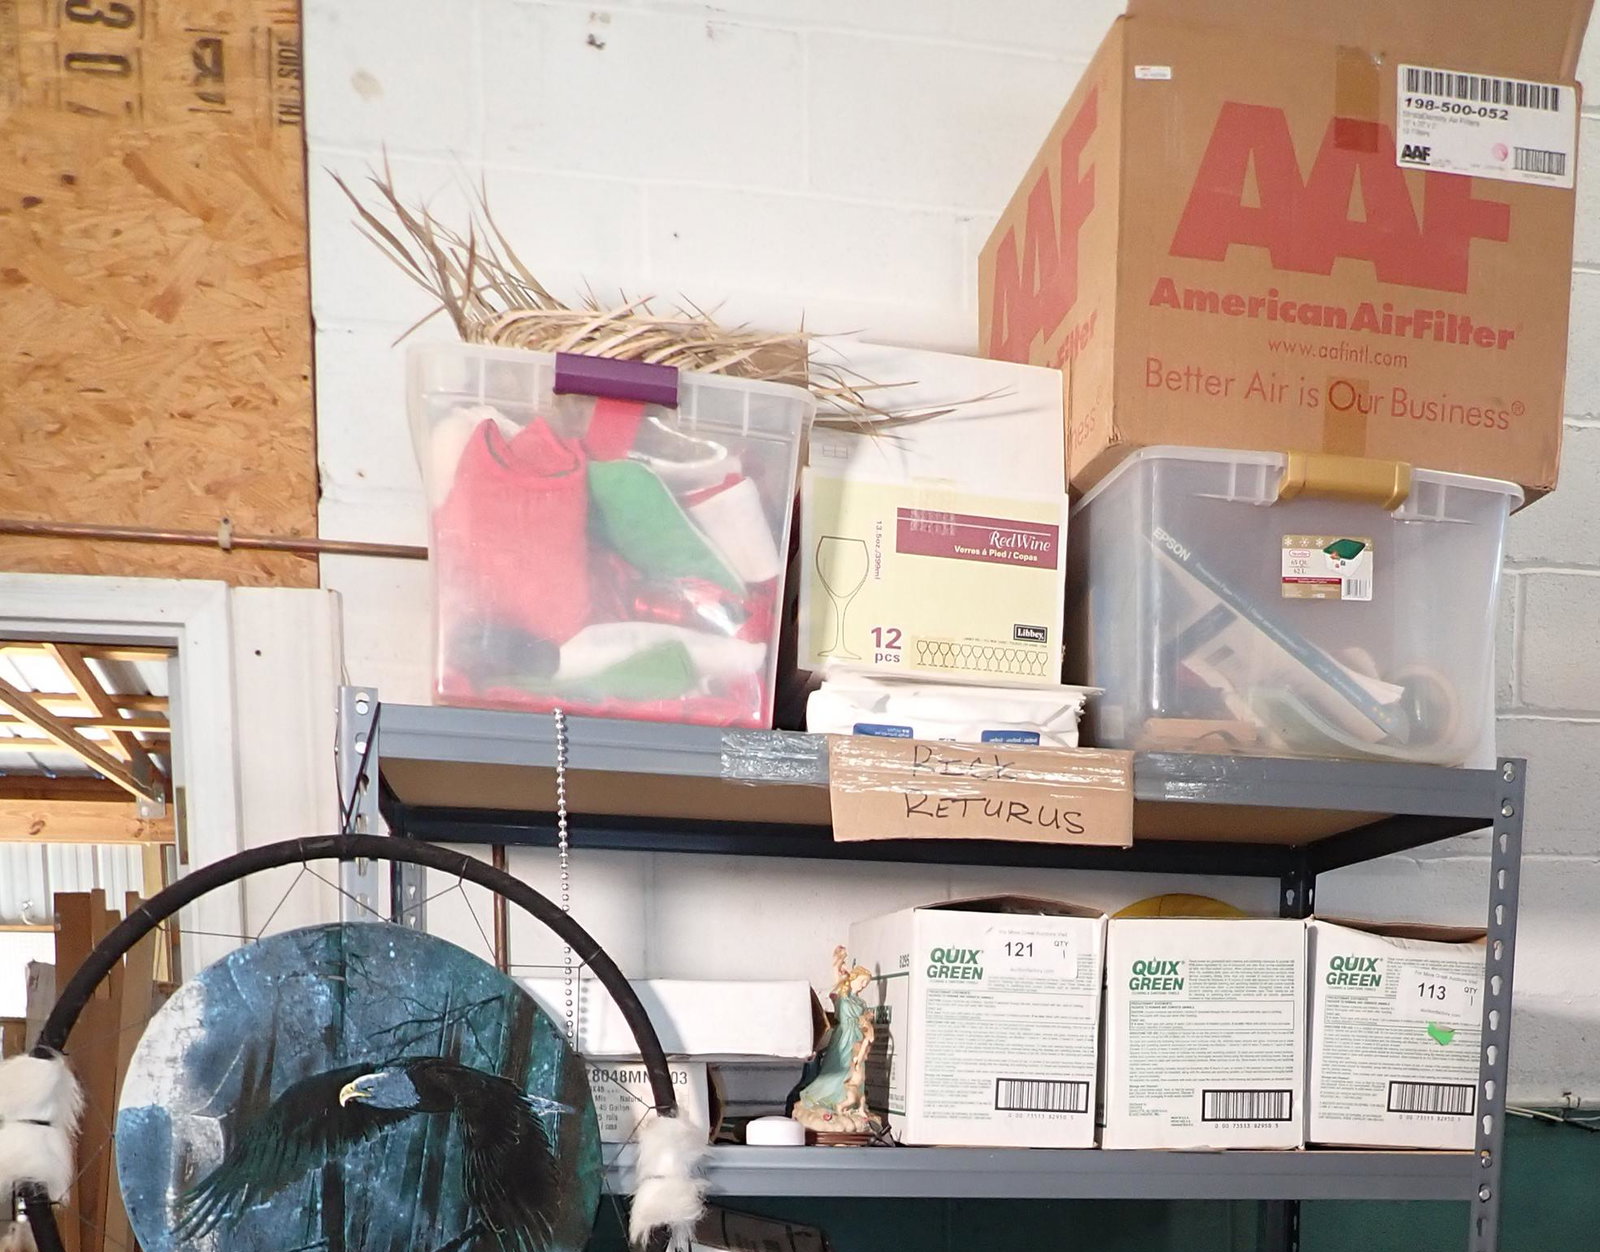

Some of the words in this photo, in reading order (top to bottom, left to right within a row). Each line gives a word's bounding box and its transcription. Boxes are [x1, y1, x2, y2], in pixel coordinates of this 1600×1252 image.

[1405, 98, 1509, 121] 198-500-052
[1402, 144, 1431, 160] AAF
[1268, 338, 1408, 369] www.aafintl.com
[1146, 358, 1235, 397] Better
[1245, 371, 1289, 405] Air
[1300, 378, 1319, 407] is
[1329, 380, 1384, 415] Our
[1152, 526, 1192, 562] EPSON
[1013, 552, 1038, 562] Copas
[871, 627, 902, 650] 12
[875, 651, 901, 663] pcs
[930, 947, 980, 965] QUIX
[1004, 941, 1034, 957] 121
[926, 964, 983, 980] GREEN
[1132, 959, 1180, 976] QUIX
[1330, 956, 1378, 972] QUIX
[1129, 977, 1184, 991] GREEN
[1326, 972, 1382, 987] GREEN
[1418, 982, 1446, 1000] 113
[1464, 986, 1478, 994] QTY
